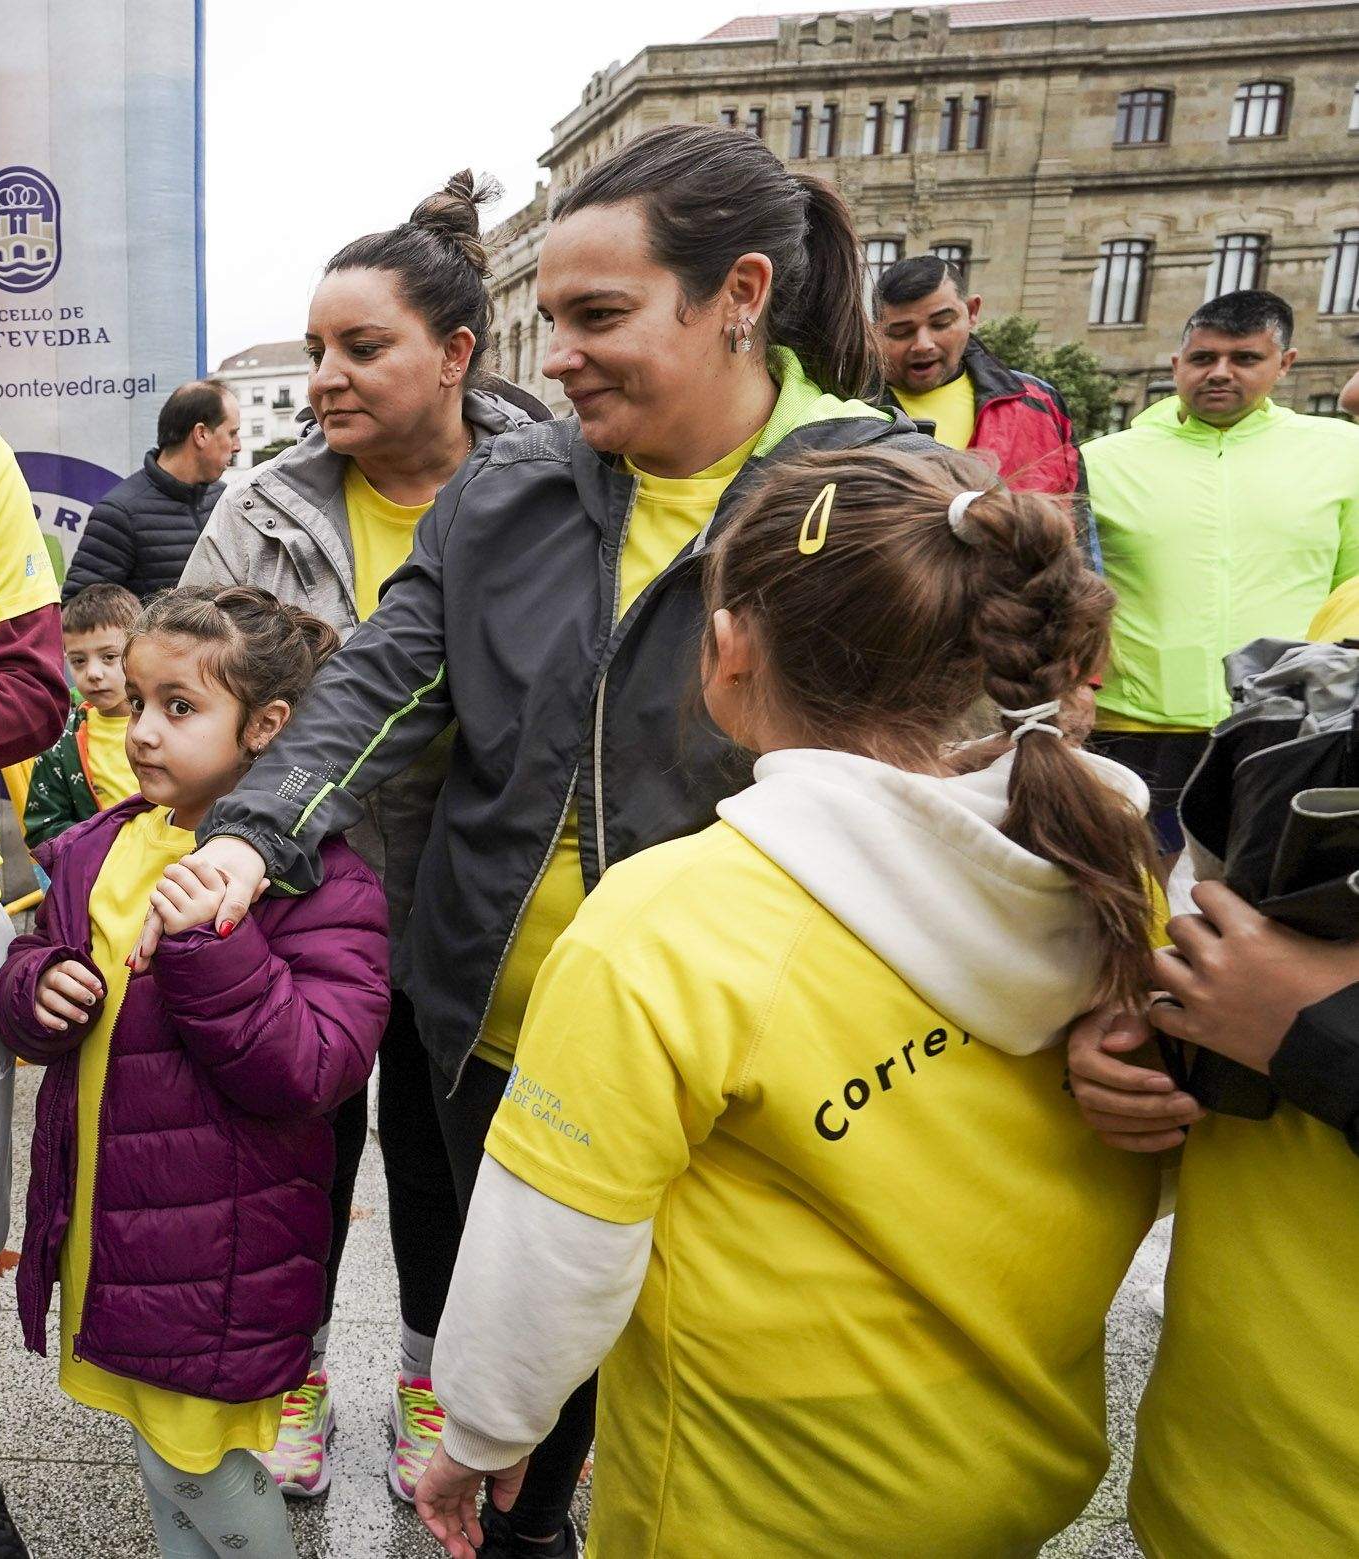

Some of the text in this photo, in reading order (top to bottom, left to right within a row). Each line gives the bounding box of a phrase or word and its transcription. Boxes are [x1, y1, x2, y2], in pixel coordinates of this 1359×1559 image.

[60, 307, 84, 321] DE
[519, 1075, 561, 1112] XUNTA
[513, 1090, 592, 1146] DE GALICIA
